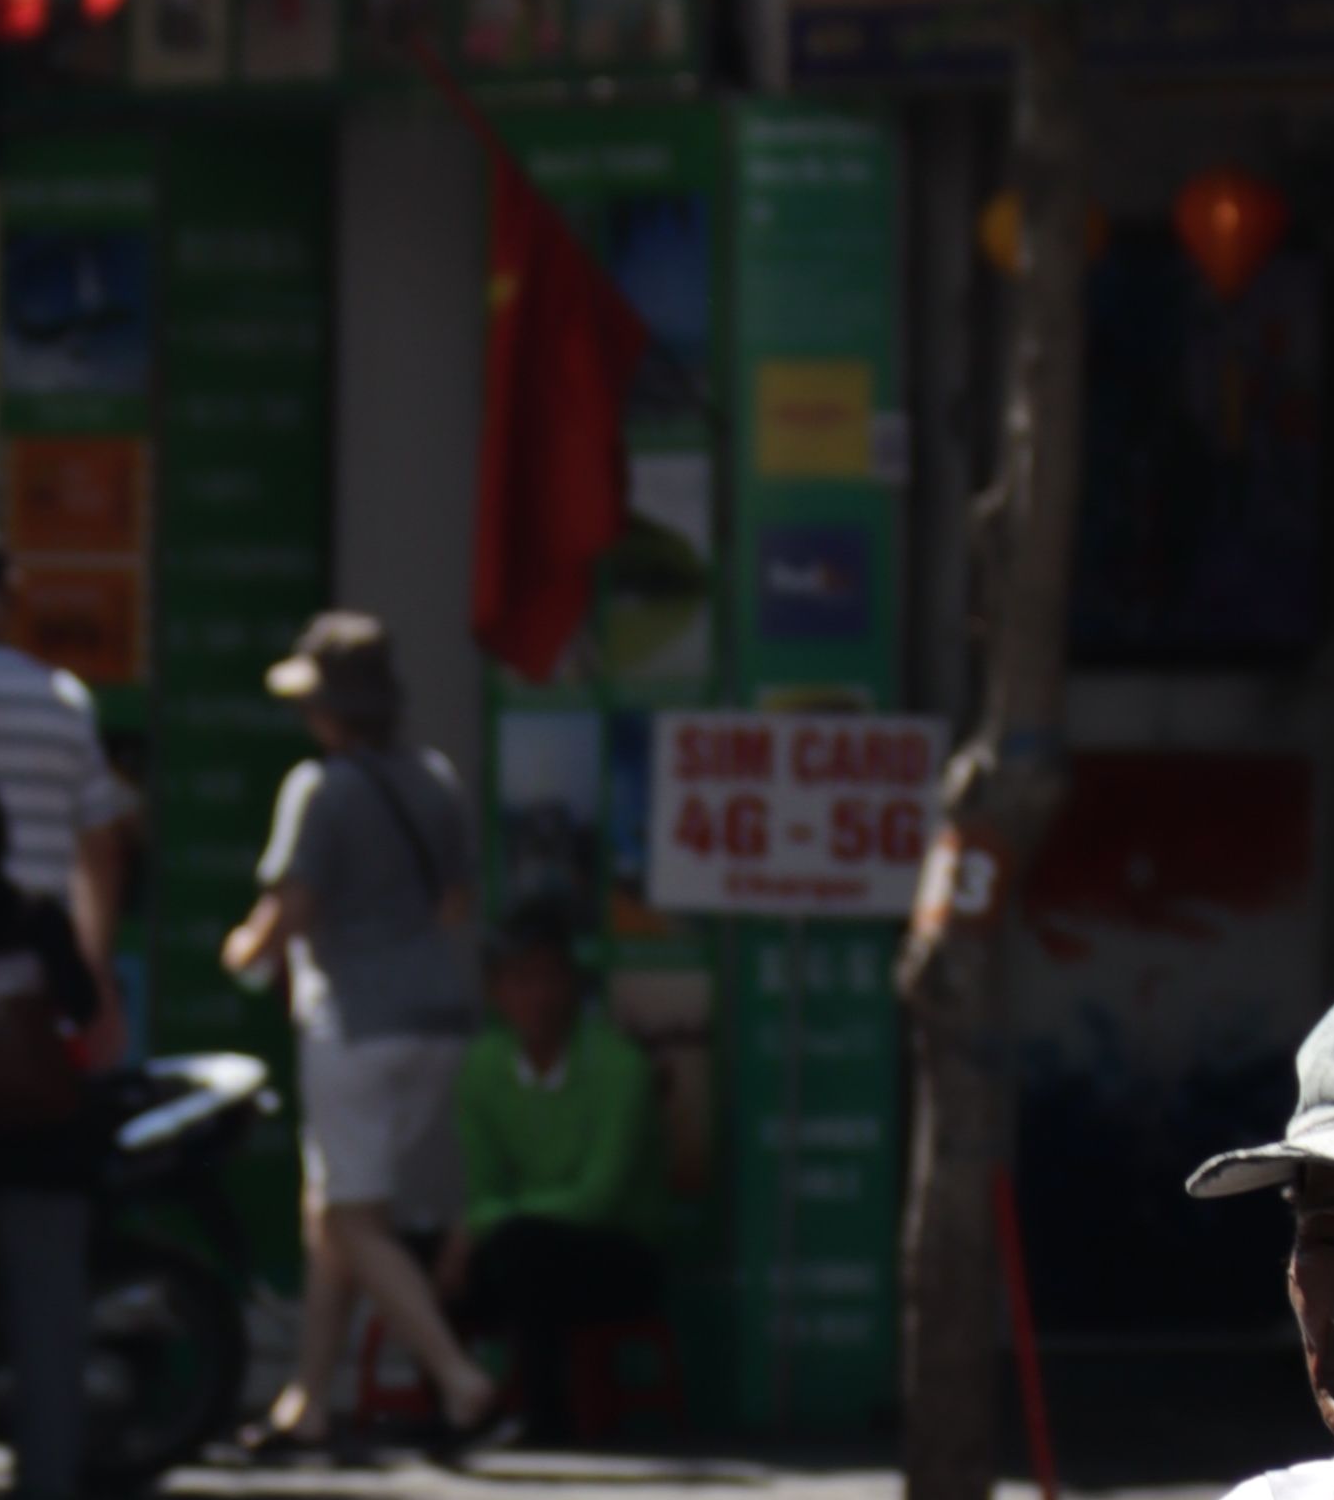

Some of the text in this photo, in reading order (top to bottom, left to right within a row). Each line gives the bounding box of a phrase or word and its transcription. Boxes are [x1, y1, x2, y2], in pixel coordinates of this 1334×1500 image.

[675, 724, 929, 788] SIM CARD
[675, 795, 768, 858] 4G
[830, 800, 924, 864] 5G
